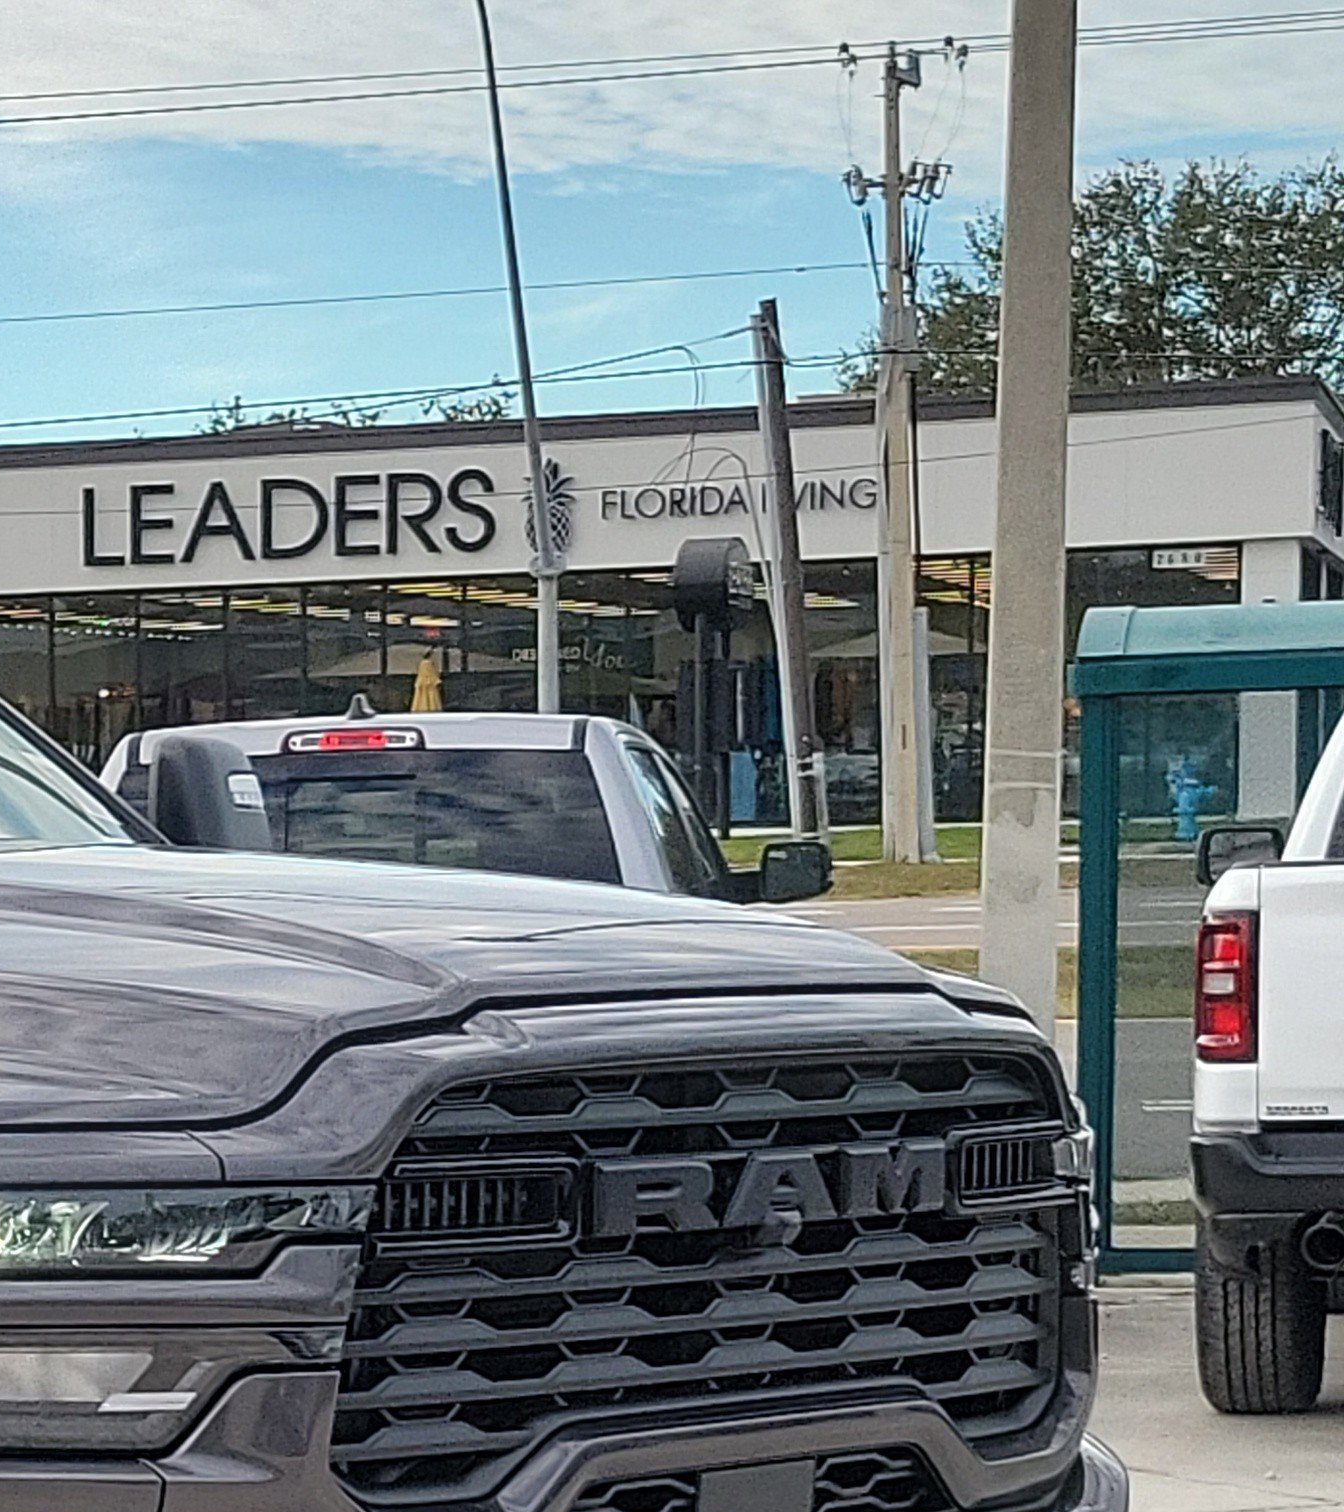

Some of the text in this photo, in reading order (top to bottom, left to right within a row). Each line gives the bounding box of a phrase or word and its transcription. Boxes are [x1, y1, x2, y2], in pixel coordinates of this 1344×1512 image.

[81, 468, 497, 567] LEADERS
[601, 484, 750, 520] FLORIDA
[590, 1138, 946, 1236] RAM
